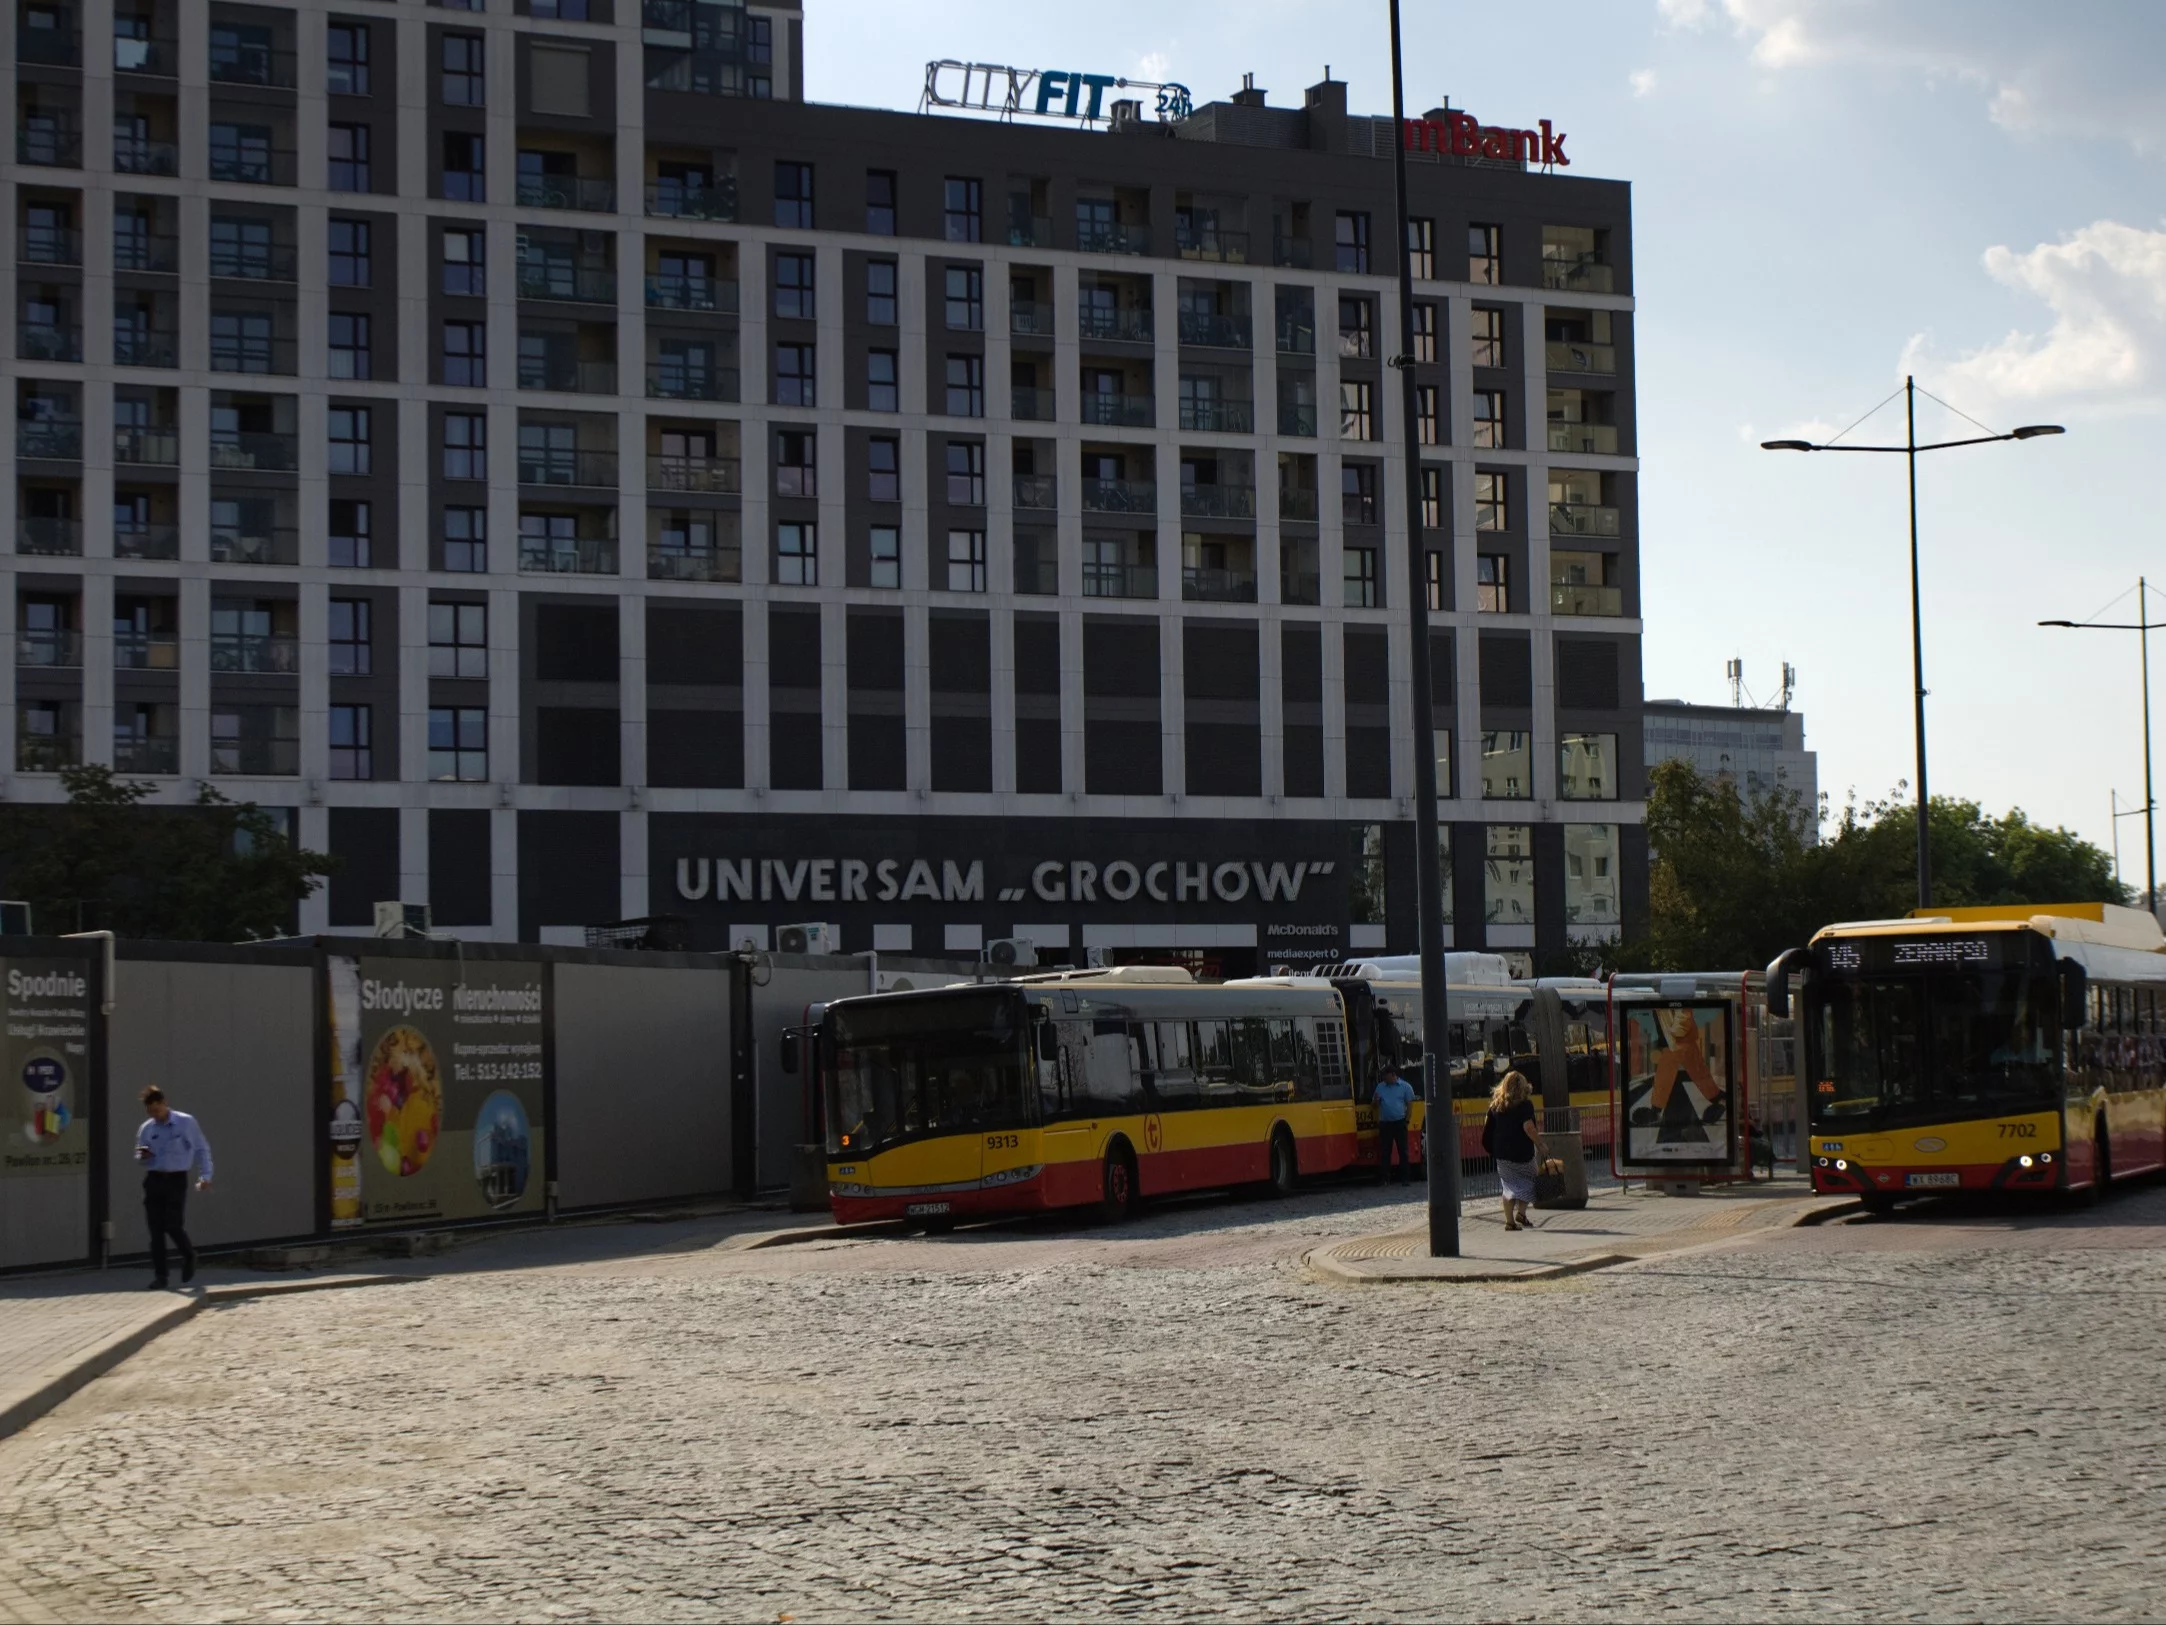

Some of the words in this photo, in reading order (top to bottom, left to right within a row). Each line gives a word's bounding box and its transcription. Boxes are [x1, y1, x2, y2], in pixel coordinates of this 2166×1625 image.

[1155, 93, 1193, 118] 24h
[1403, 112, 1570, 166] mBank
[676, 858, 985, 902] UNIVERSAM
[1267, 924, 1339, 936] McDonald's
[1267, 949, 1329, 960] mediaexpert
[8, 969, 87, 1002] Spodnie
[1998, 1124, 2037, 1138] 7702
[841, 1134, 850, 1146] 3
[987, 1135, 1019, 1149] 9313
